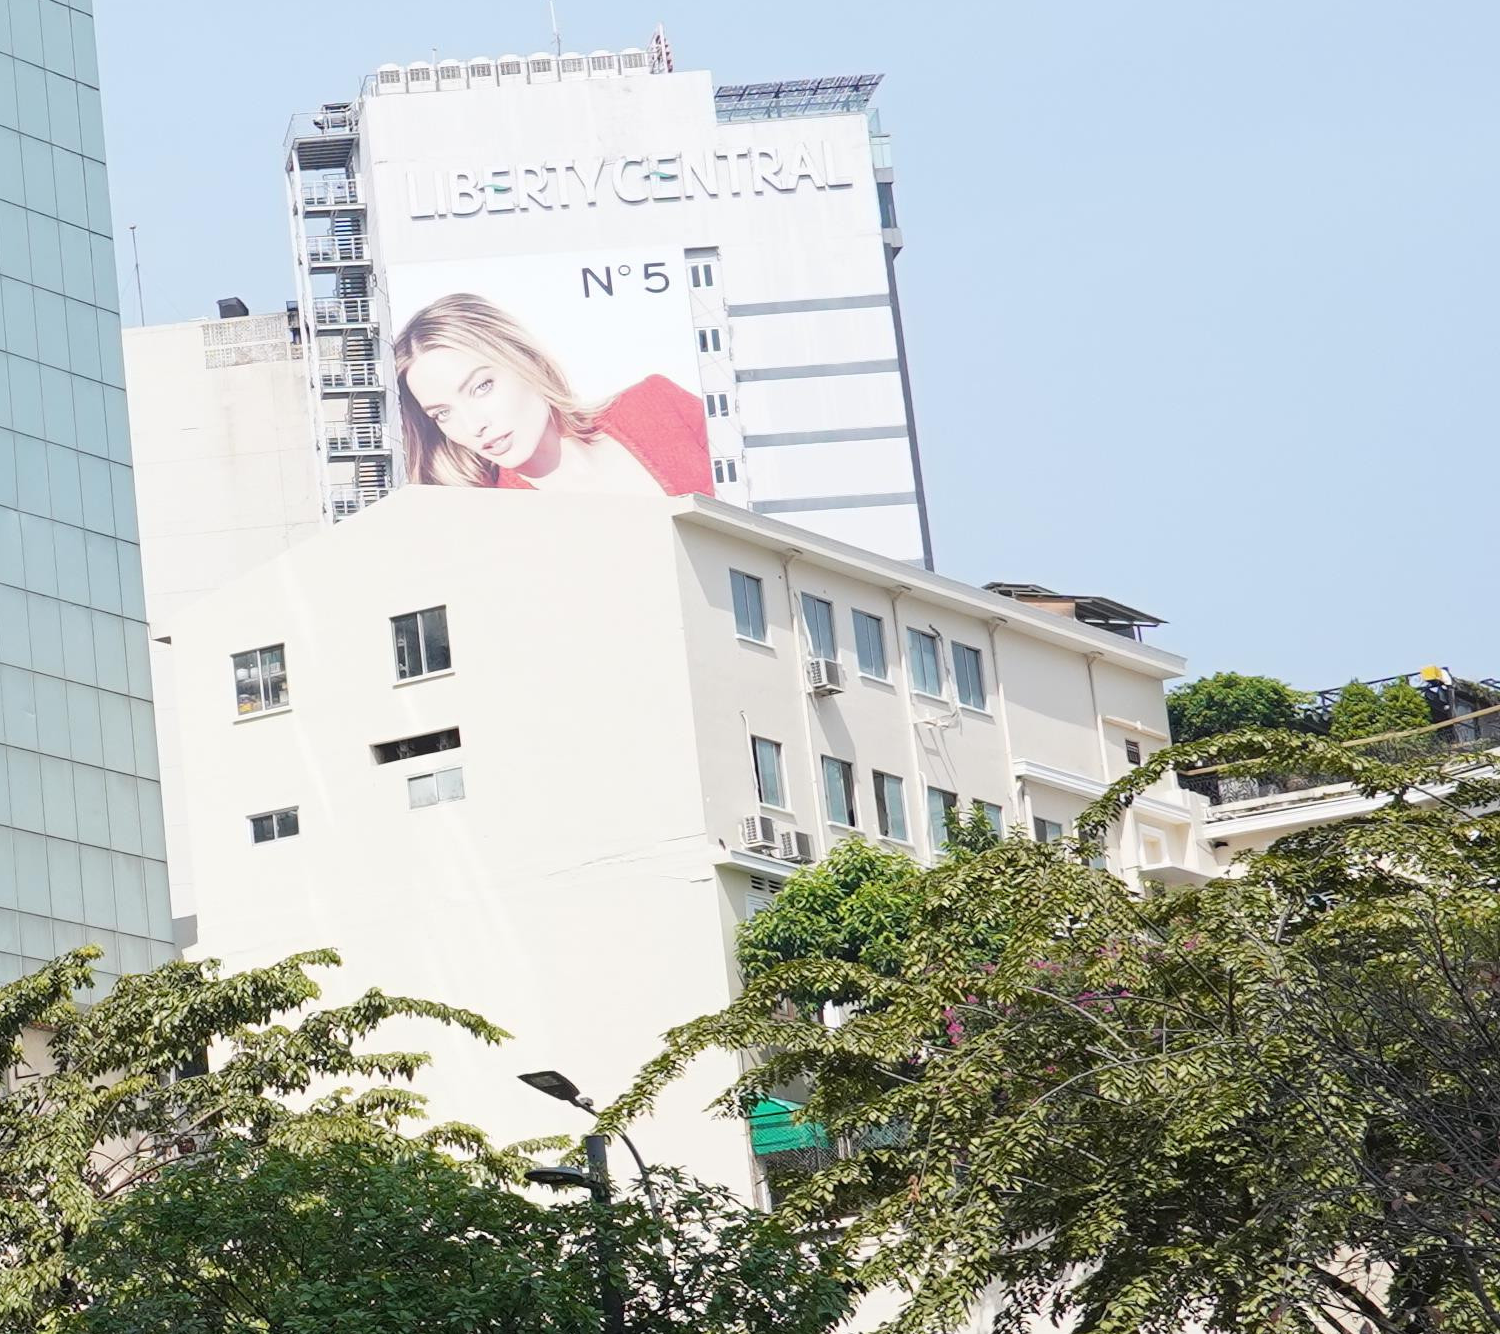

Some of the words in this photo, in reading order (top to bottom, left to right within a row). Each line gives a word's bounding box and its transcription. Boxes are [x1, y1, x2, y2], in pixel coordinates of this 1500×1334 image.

[406, 158, 603, 218] LIBERTY
[611, 141, 853, 204] CENTRAL
[644, 262, 670, 293] 5
